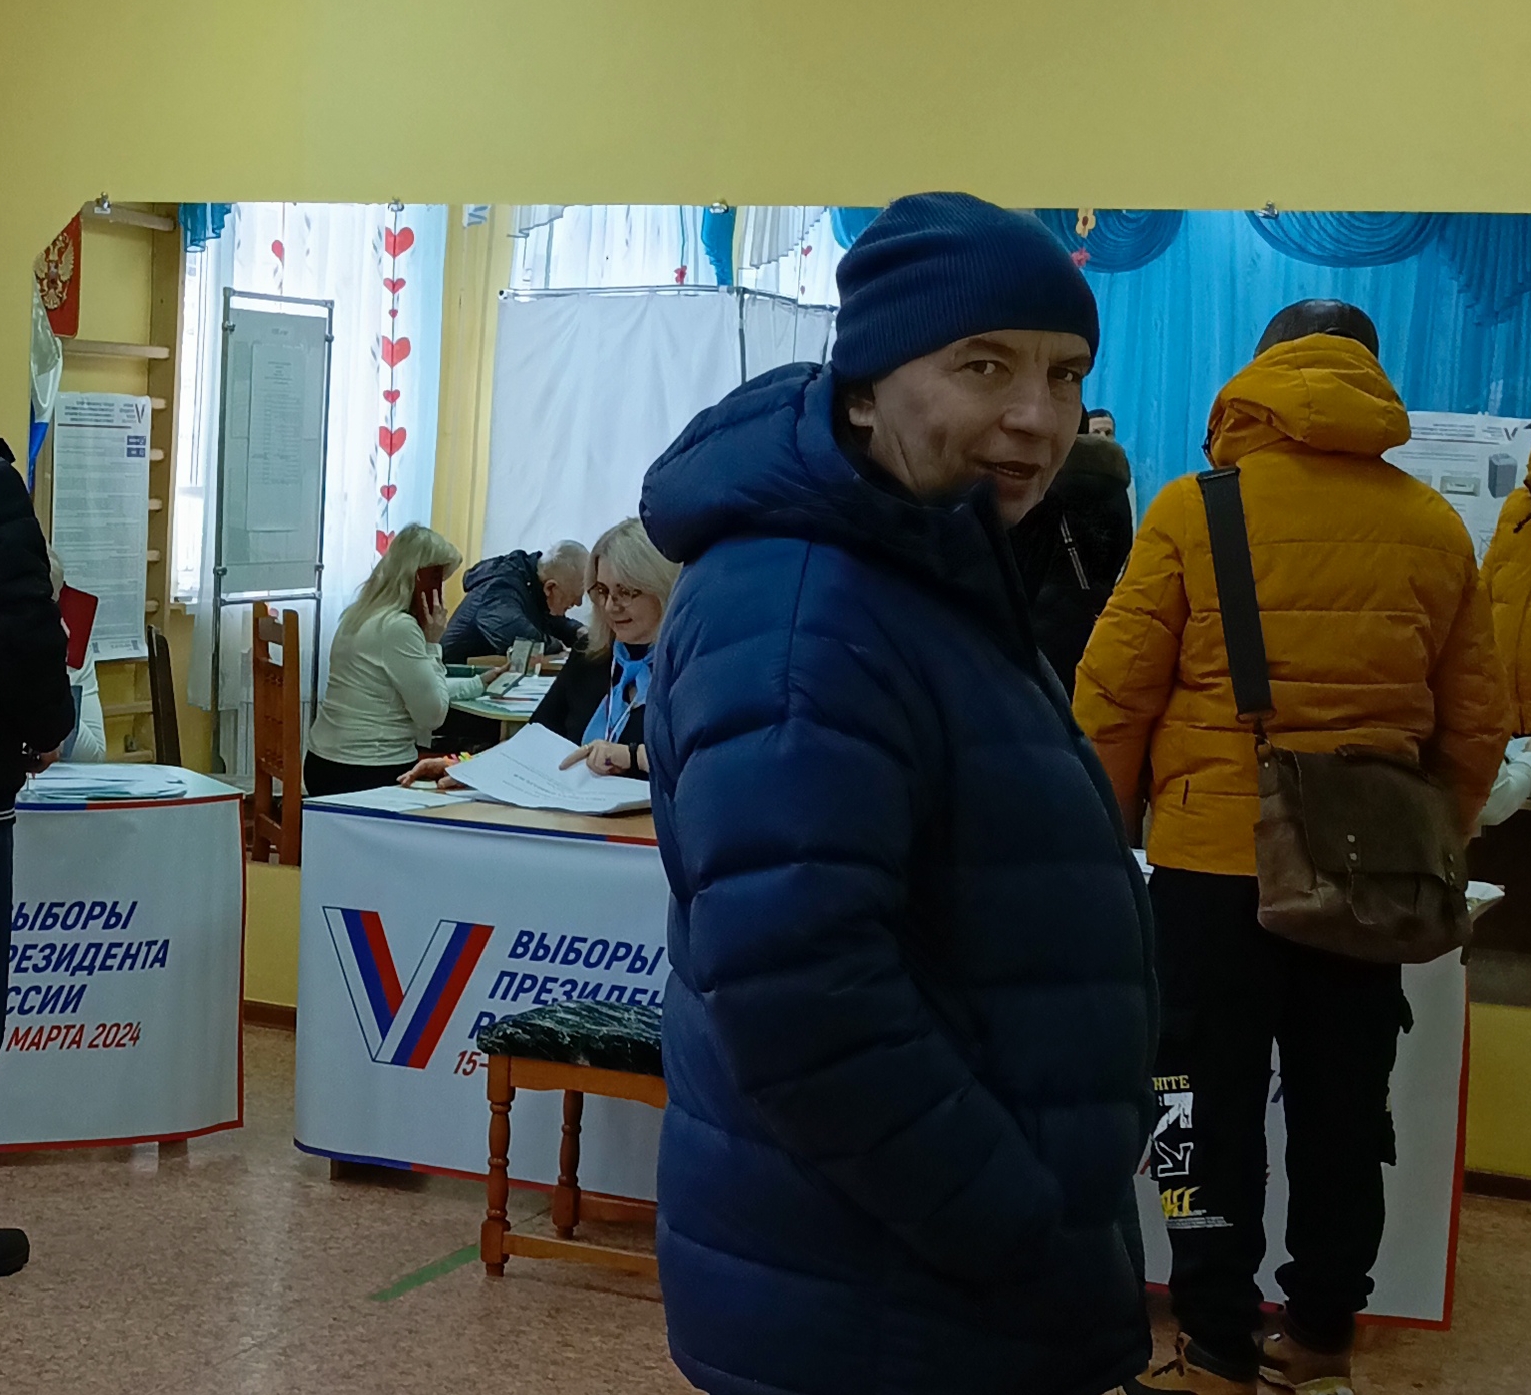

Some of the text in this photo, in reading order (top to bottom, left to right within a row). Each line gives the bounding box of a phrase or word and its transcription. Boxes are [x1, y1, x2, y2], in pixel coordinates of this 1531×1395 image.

[11, 900, 138, 931] ЫБОРЫ
[507, 929, 666, 976] ВЫБОРЫ
[6, 984, 87, 1016] ССИИ
[5, 1021, 141, 1052] МАРТА 2024
[453, 1050, 488, 1076] 15-
[1152, 1075, 1190, 1091] HITE
